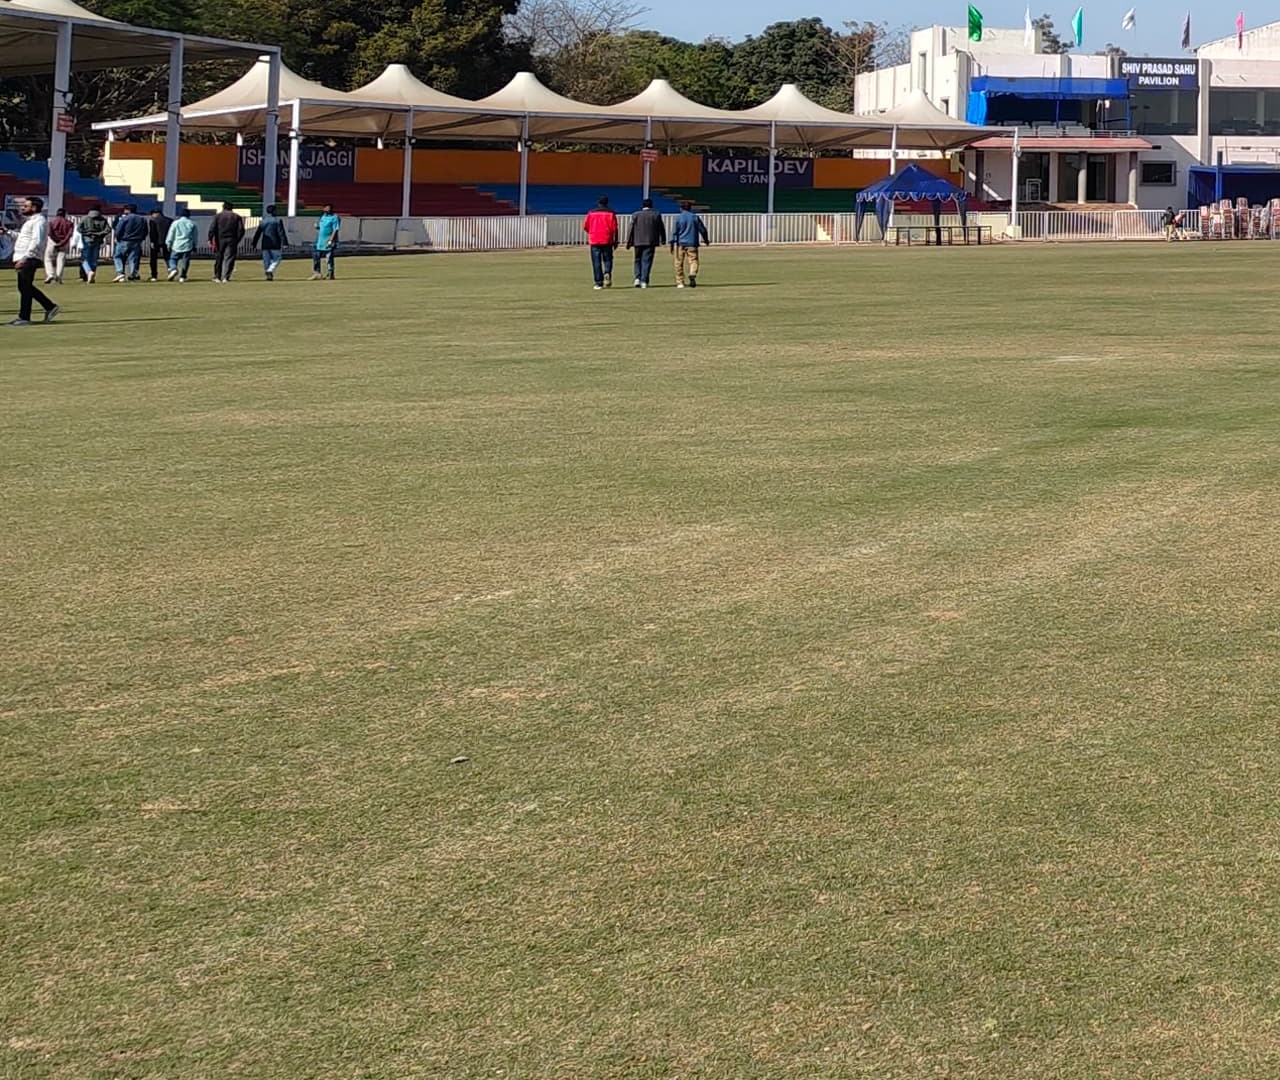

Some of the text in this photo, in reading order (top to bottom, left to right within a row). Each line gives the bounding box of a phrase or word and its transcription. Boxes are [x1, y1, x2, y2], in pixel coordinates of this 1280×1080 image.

[1122, 62, 1196, 75] SHIV PRASAD SAHU
[1138, 76, 1179, 85] PAVILION
[306, 151, 352, 166] JAGGI
[708, 158, 764, 173] KAPIL
[740, 174, 776, 184] STAN
